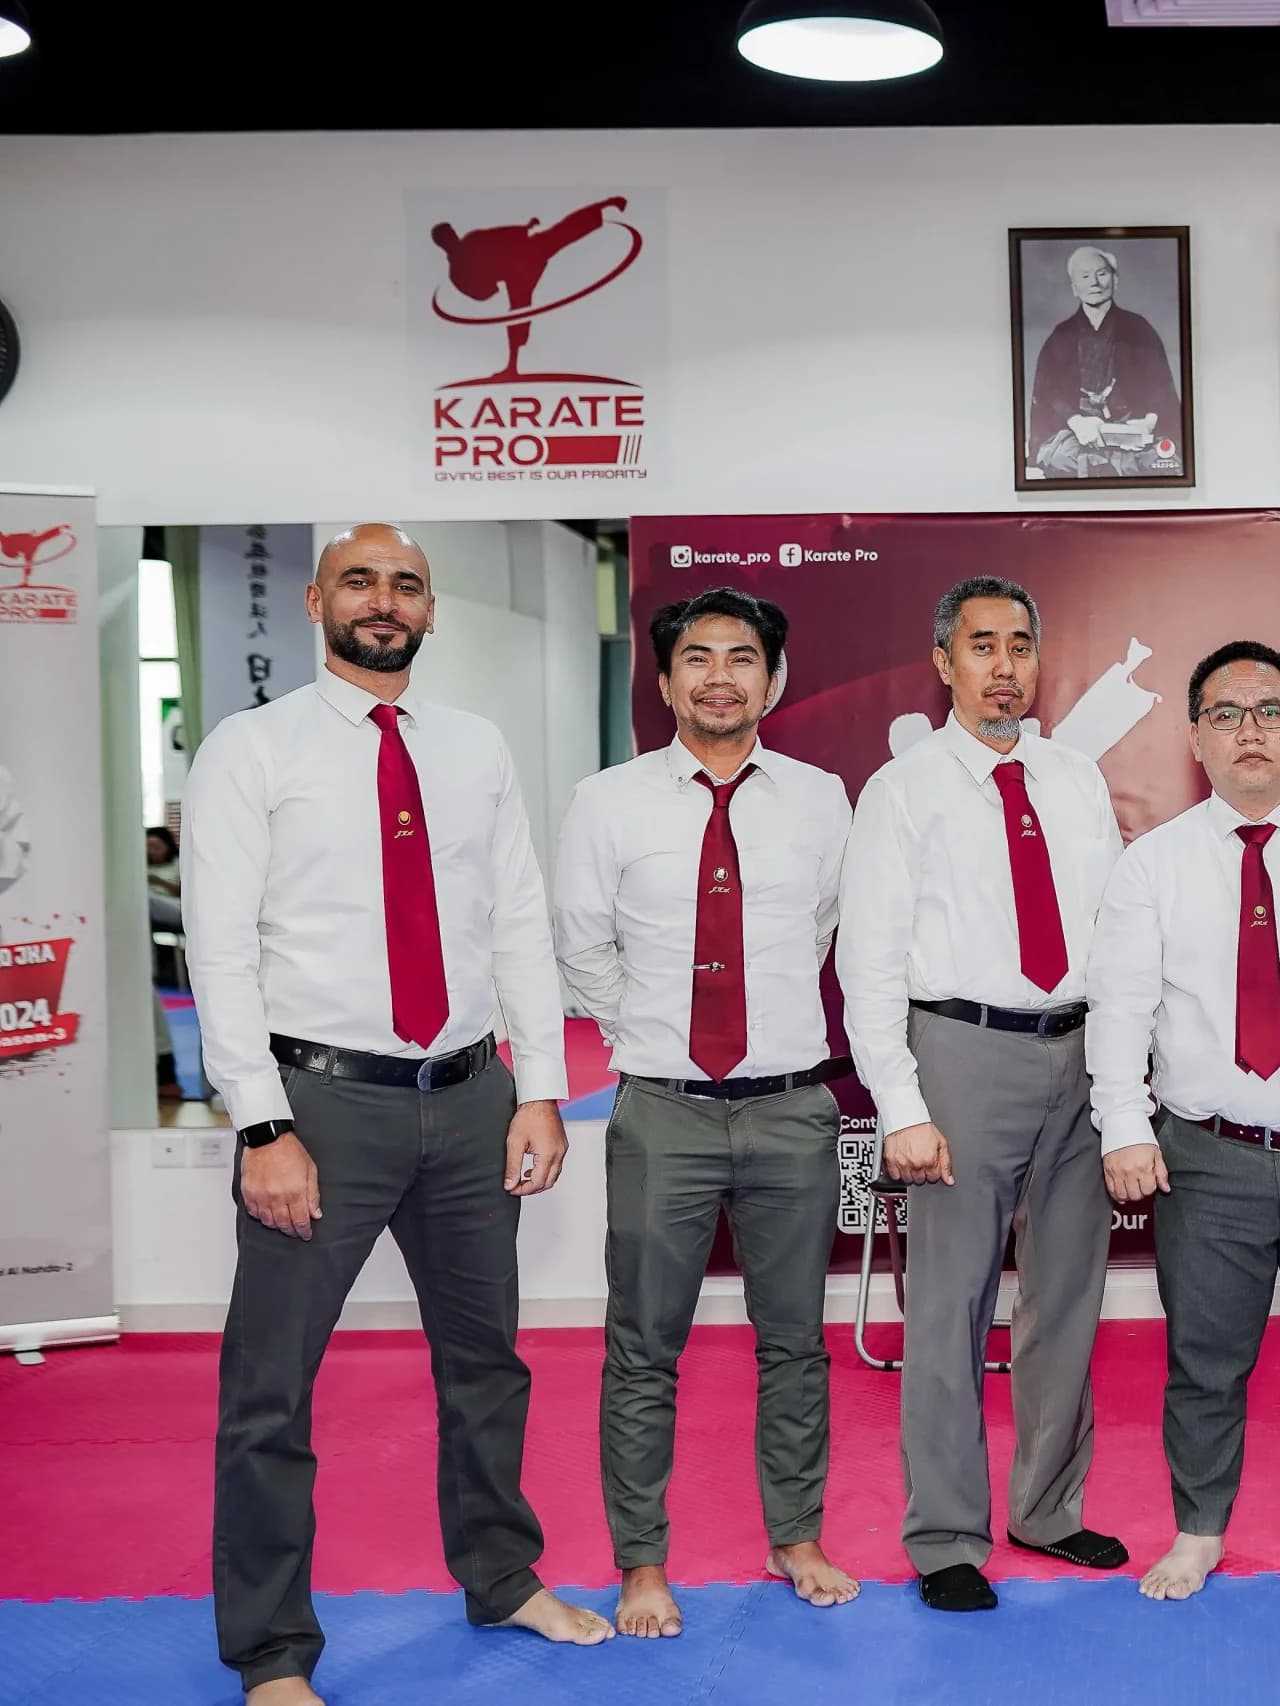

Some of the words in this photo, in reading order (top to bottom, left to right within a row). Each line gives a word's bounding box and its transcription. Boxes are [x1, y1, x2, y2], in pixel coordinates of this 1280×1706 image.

[434, 395, 645, 428] KARATE
[435, 434, 544, 466] PRO
[435, 471, 483, 482] GIVING
[487, 470, 525, 481] BEST
[529, 470, 543, 480] IS
[547, 470, 577, 480] OUR
[582, 468, 647, 479] PRIORITY
[694, 551, 771, 565] karate_pro
[804, 549, 851, 562] Karate
[855, 548, 878, 561] Pro
[0, 998, 52, 1032] 024
